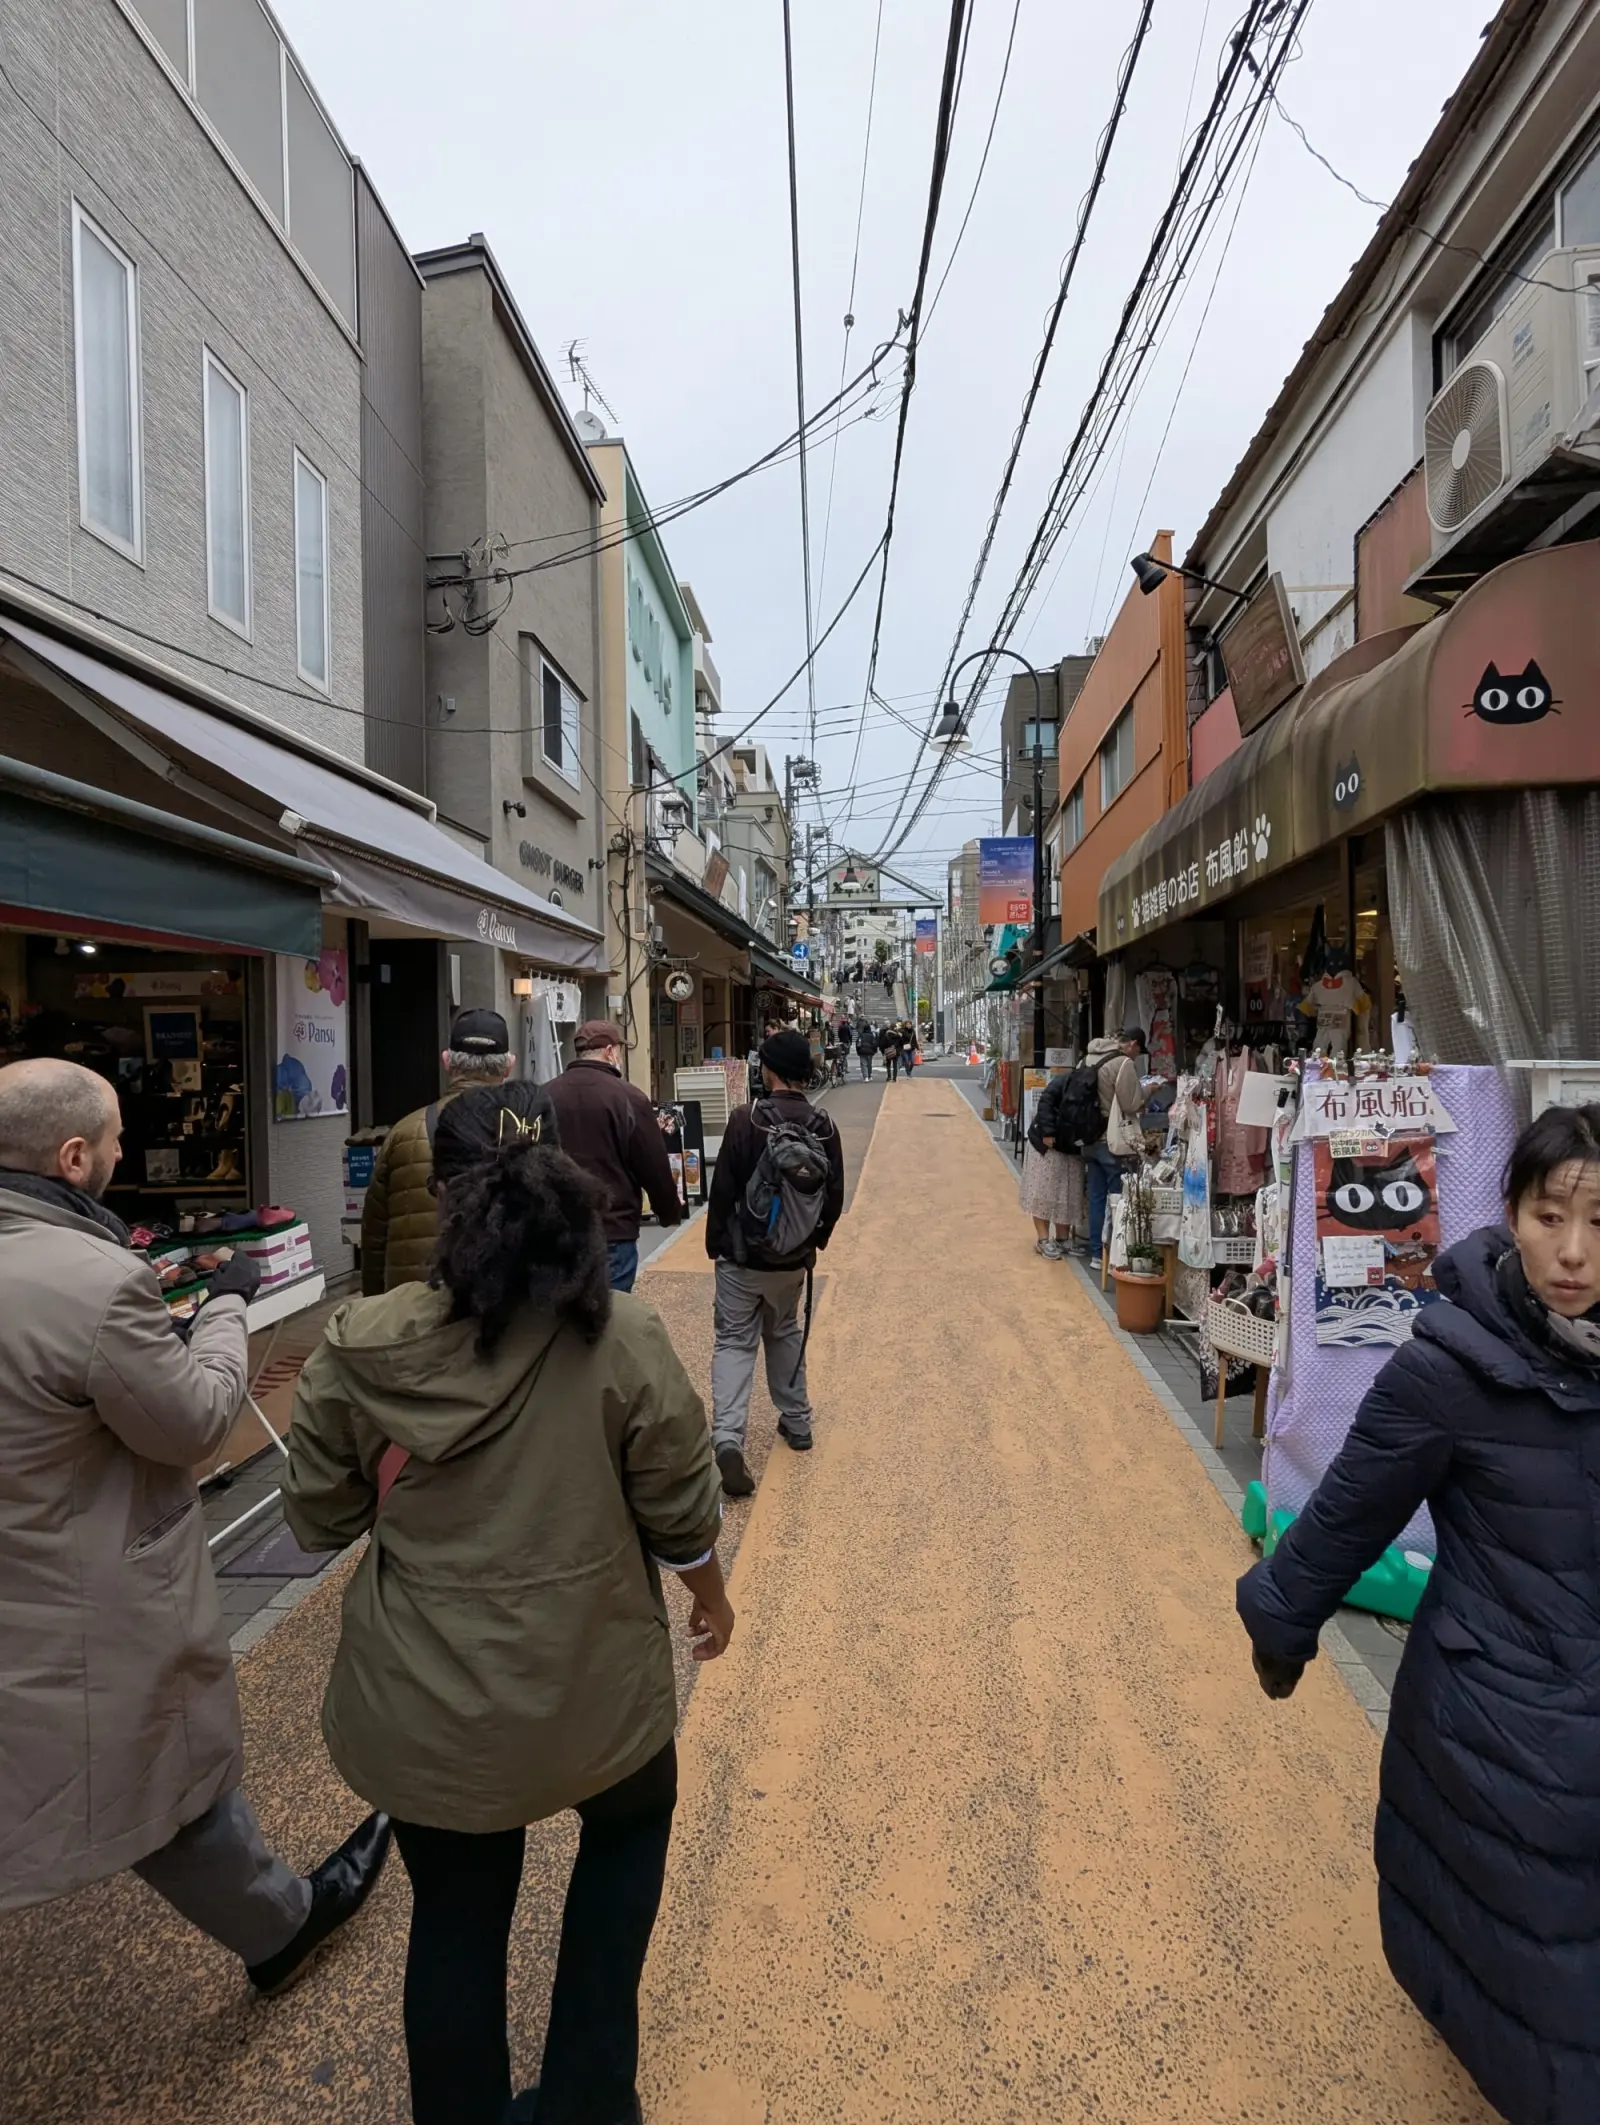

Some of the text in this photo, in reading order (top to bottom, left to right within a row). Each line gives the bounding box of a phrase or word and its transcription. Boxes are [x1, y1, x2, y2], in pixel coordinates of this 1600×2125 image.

[1141, 827, 1249, 925] 猫雑貨のお店 布風船
[489, 912, 518, 951] Pansy
[308, 1022, 336, 1048] Pansy
[1316, 1085, 1429, 1120] 布風船
